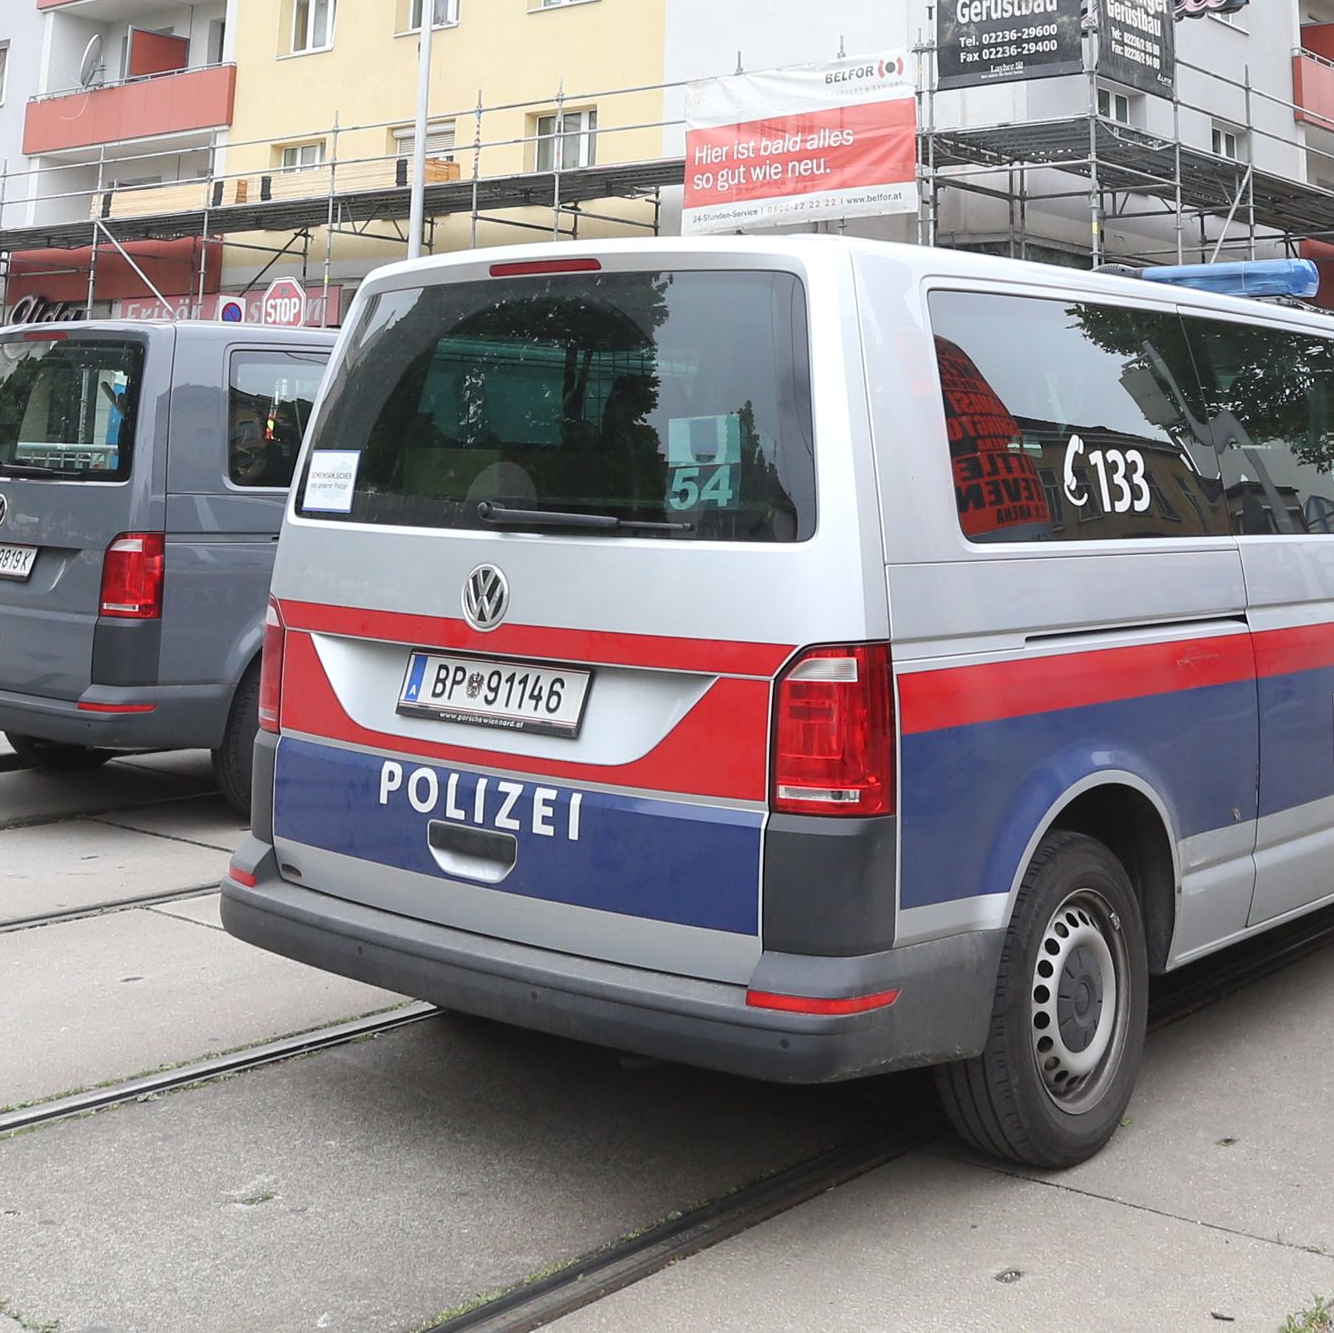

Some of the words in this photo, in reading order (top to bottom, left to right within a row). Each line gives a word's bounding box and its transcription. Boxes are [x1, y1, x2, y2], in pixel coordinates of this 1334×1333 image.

[959, 34, 979, 48] Tel.
[982, 24, 1058, 45] 02236-29600
[959, 51, 979, 63] Fax
[982, 40, 1058, 60] 02236-29400
[825, 65, 874, 85] BELFOR
[694, 144, 730, 166] Hier
[733, 138, 755, 160] ist
[760, 132, 802, 156] bald
[807, 128, 855, 150] alles
[693, 173, 714, 190] so
[717, 167, 747, 192] gut
[751, 160, 783, 181] wie
[788, 157, 831, 177] neu.
[692, 208, 758, 224] 24-Stunden-Service
[846, 192, 903, 205] www.belfor.at
[267, 297, 299, 323] STOP
[669, 464, 733, 510] 54
[1088, 449, 1151, 513] 133
[431, 664, 466, 700] BP
[483, 670, 565, 713] 91146
[379, 760, 582, 841] POLIZEI
